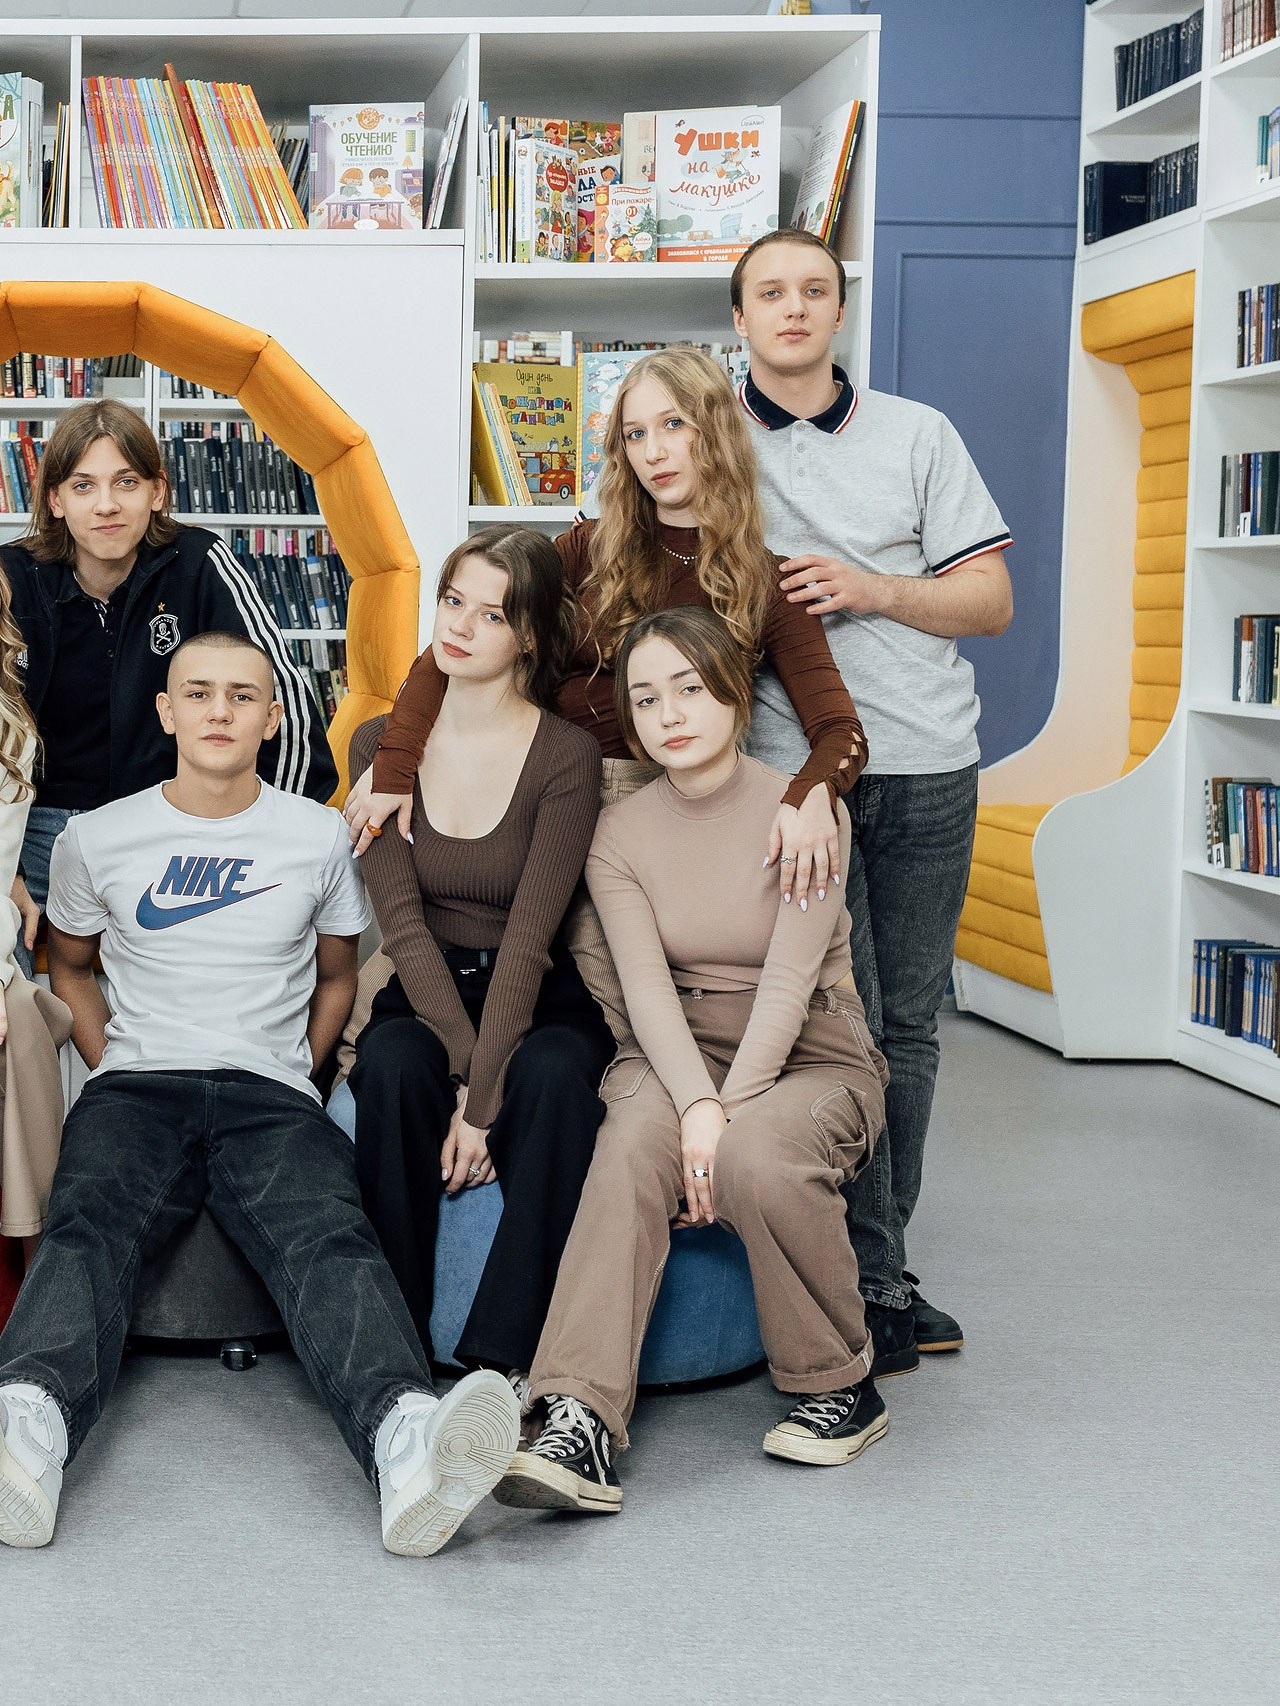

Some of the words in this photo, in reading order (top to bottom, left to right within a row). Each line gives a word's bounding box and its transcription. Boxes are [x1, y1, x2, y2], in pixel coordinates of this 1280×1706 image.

[341, 131, 398, 144] ОБУЧЕНИЕ
[674, 128, 760, 156] Ушки
[346, 145, 392, 156] ЧТЕНИЮ
[578, 166, 596, 175] НЫЕ
[688, 161, 710, 174] на
[578, 177, 597, 191] ЛА
[670, 174, 761, 207] макушке
[577, 193, 594, 203] ОСТ
[627, 207, 637, 216] 01
[516, 369, 534, 386] Один
[536, 373, 553, 386] день
[500, 395, 572, 411] ПОЖАРНОЙ
[505, 411, 565, 426] СТАНЦИИ
[155, 855, 255, 898] NIKE
